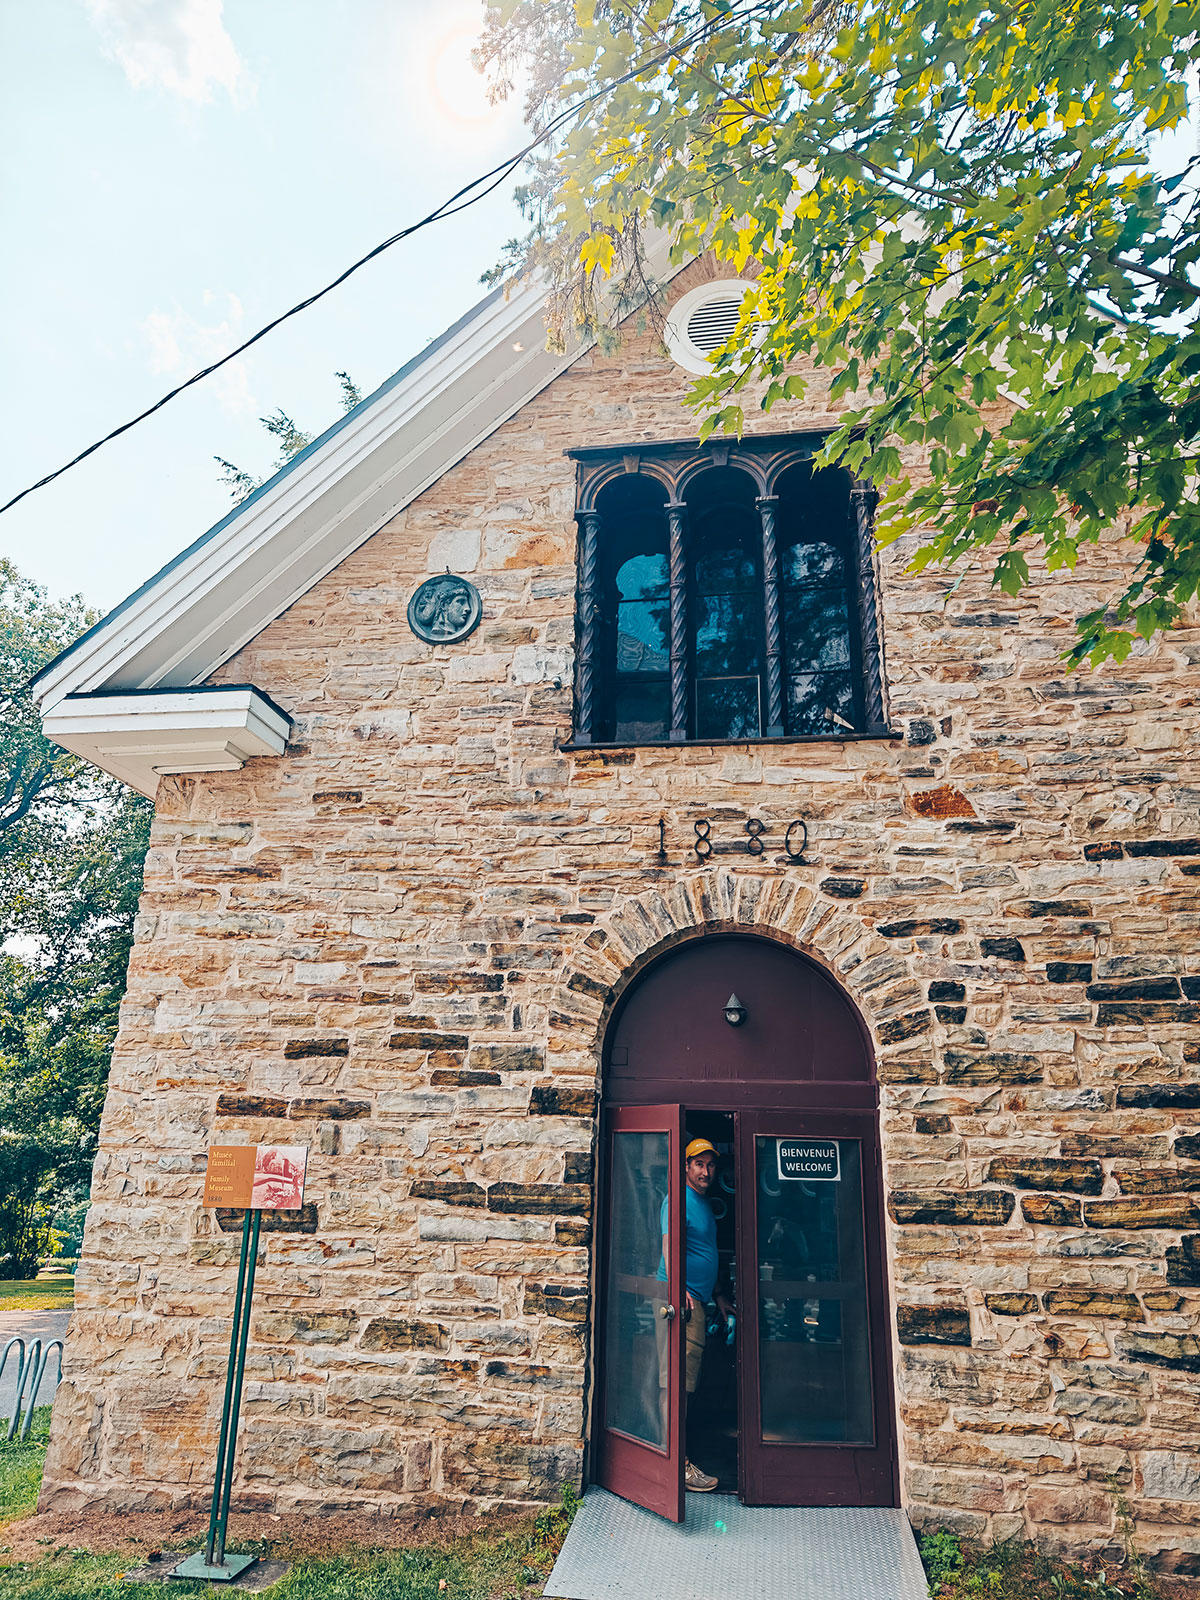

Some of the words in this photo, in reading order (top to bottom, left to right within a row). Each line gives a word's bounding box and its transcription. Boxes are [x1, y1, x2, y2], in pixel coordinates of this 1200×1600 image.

[658, 818, 808, 857] 1880
[781, 1148, 835, 1158] BIENVENUE
[211, 1159, 236, 1167] familial
[785, 1162, 833, 1172] WELCOME
[209, 1175, 231, 1184] Family
[208, 1184, 234, 1192] Museum
